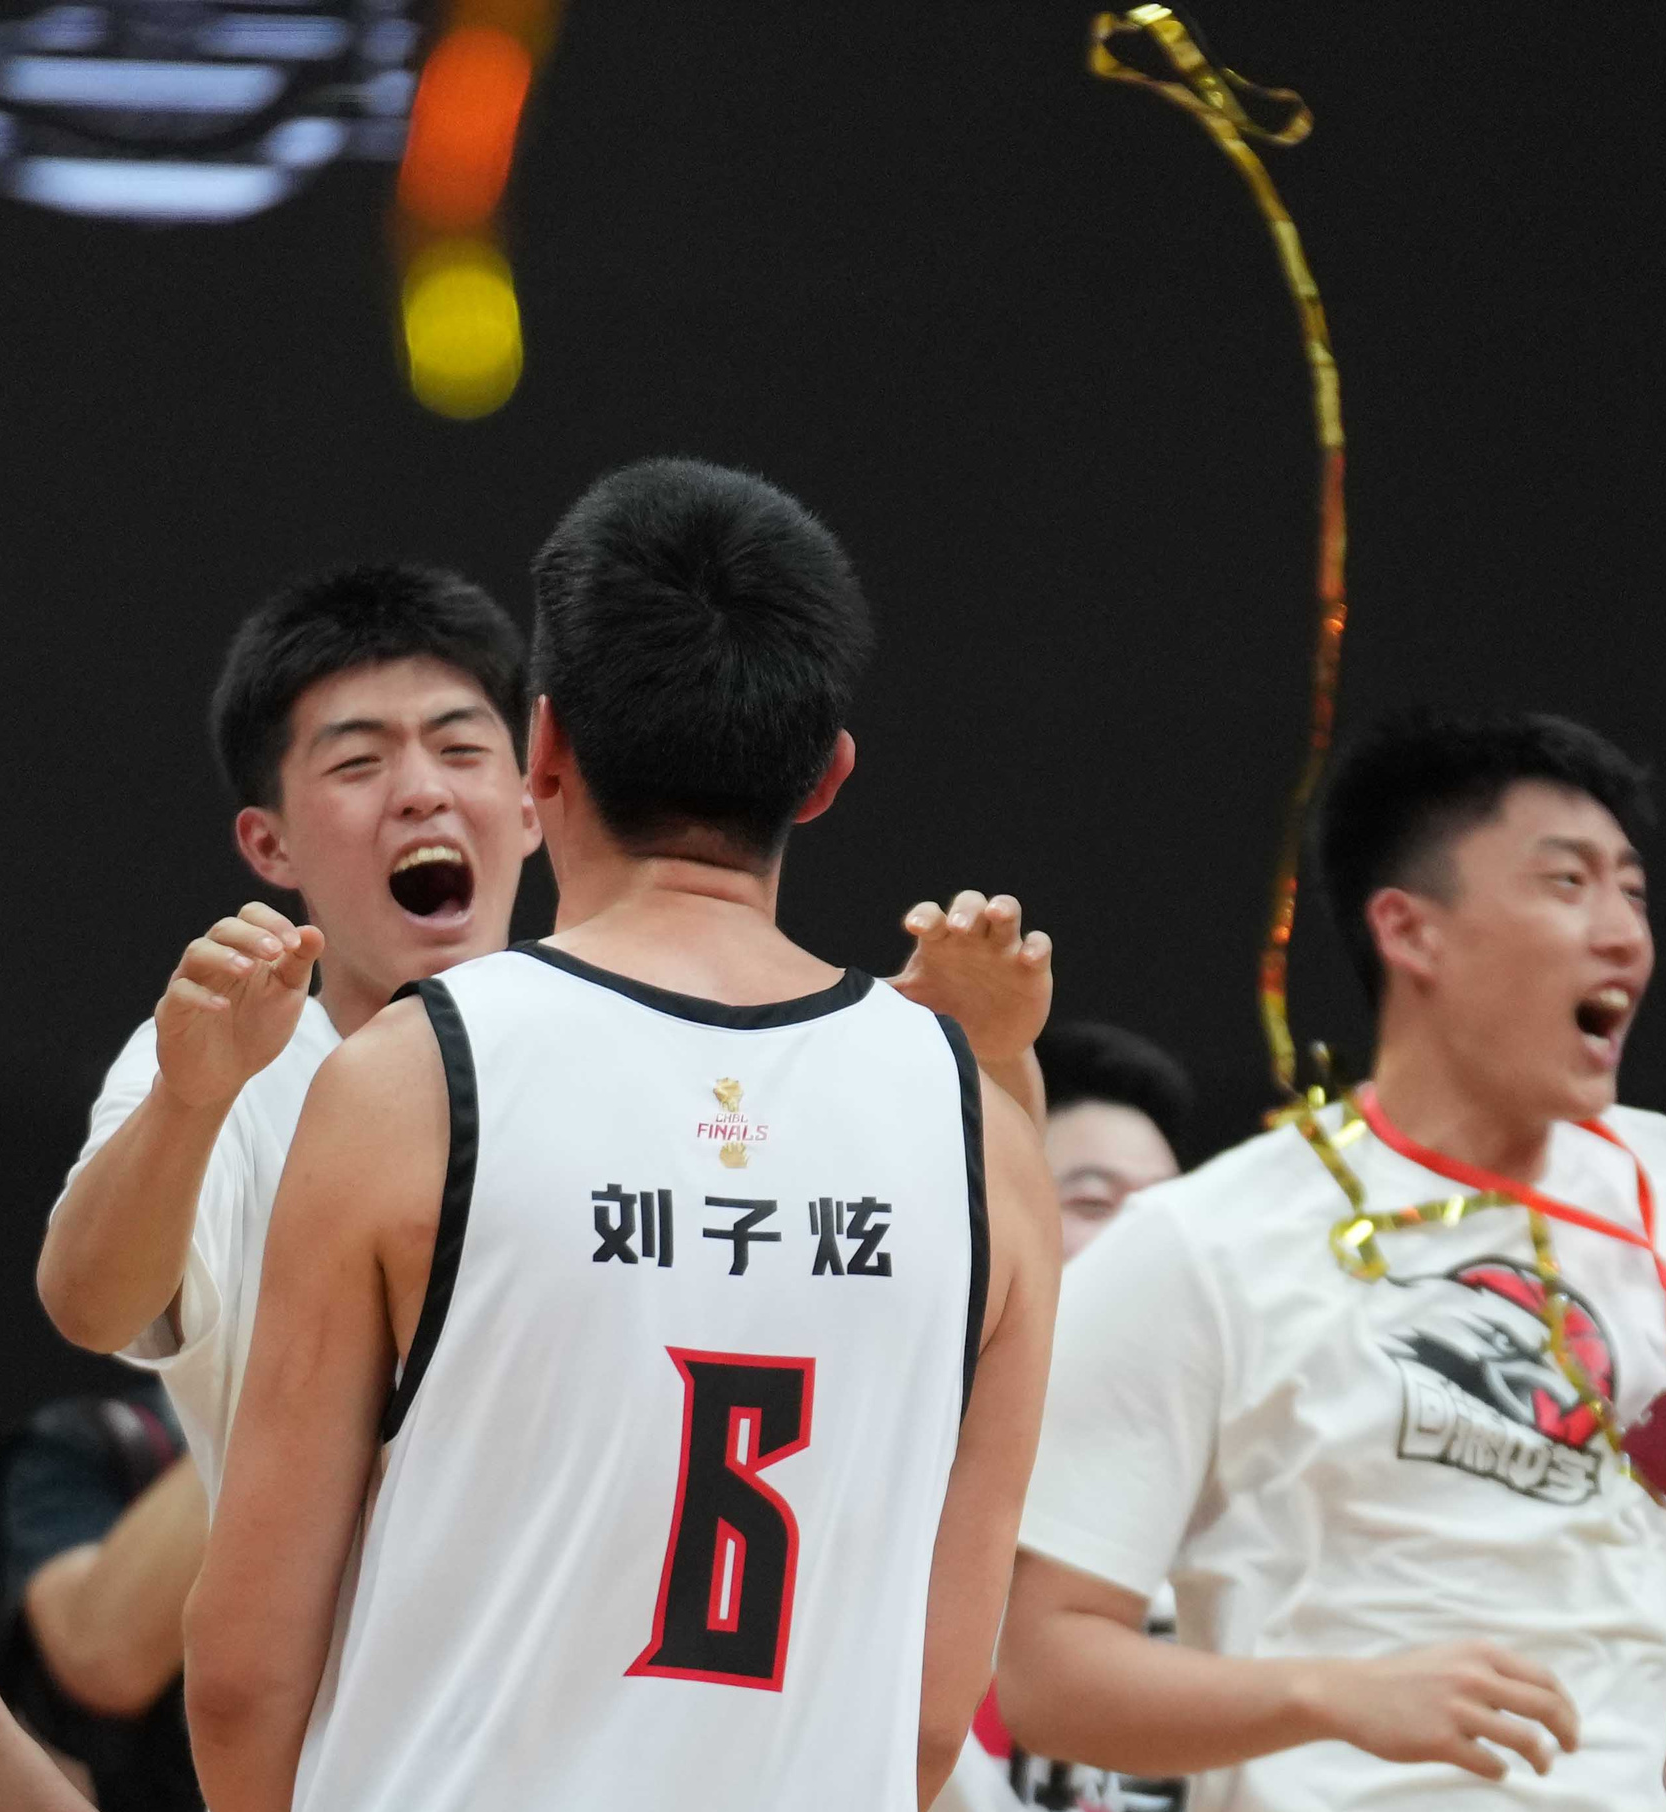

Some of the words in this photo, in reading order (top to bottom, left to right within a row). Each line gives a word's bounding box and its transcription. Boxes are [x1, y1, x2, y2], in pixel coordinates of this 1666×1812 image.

[696, 1121, 769, 1141] FINALS
[590, 1183, 893, 1278] 刘子炫
[624, 1345, 817, 1693] 6
